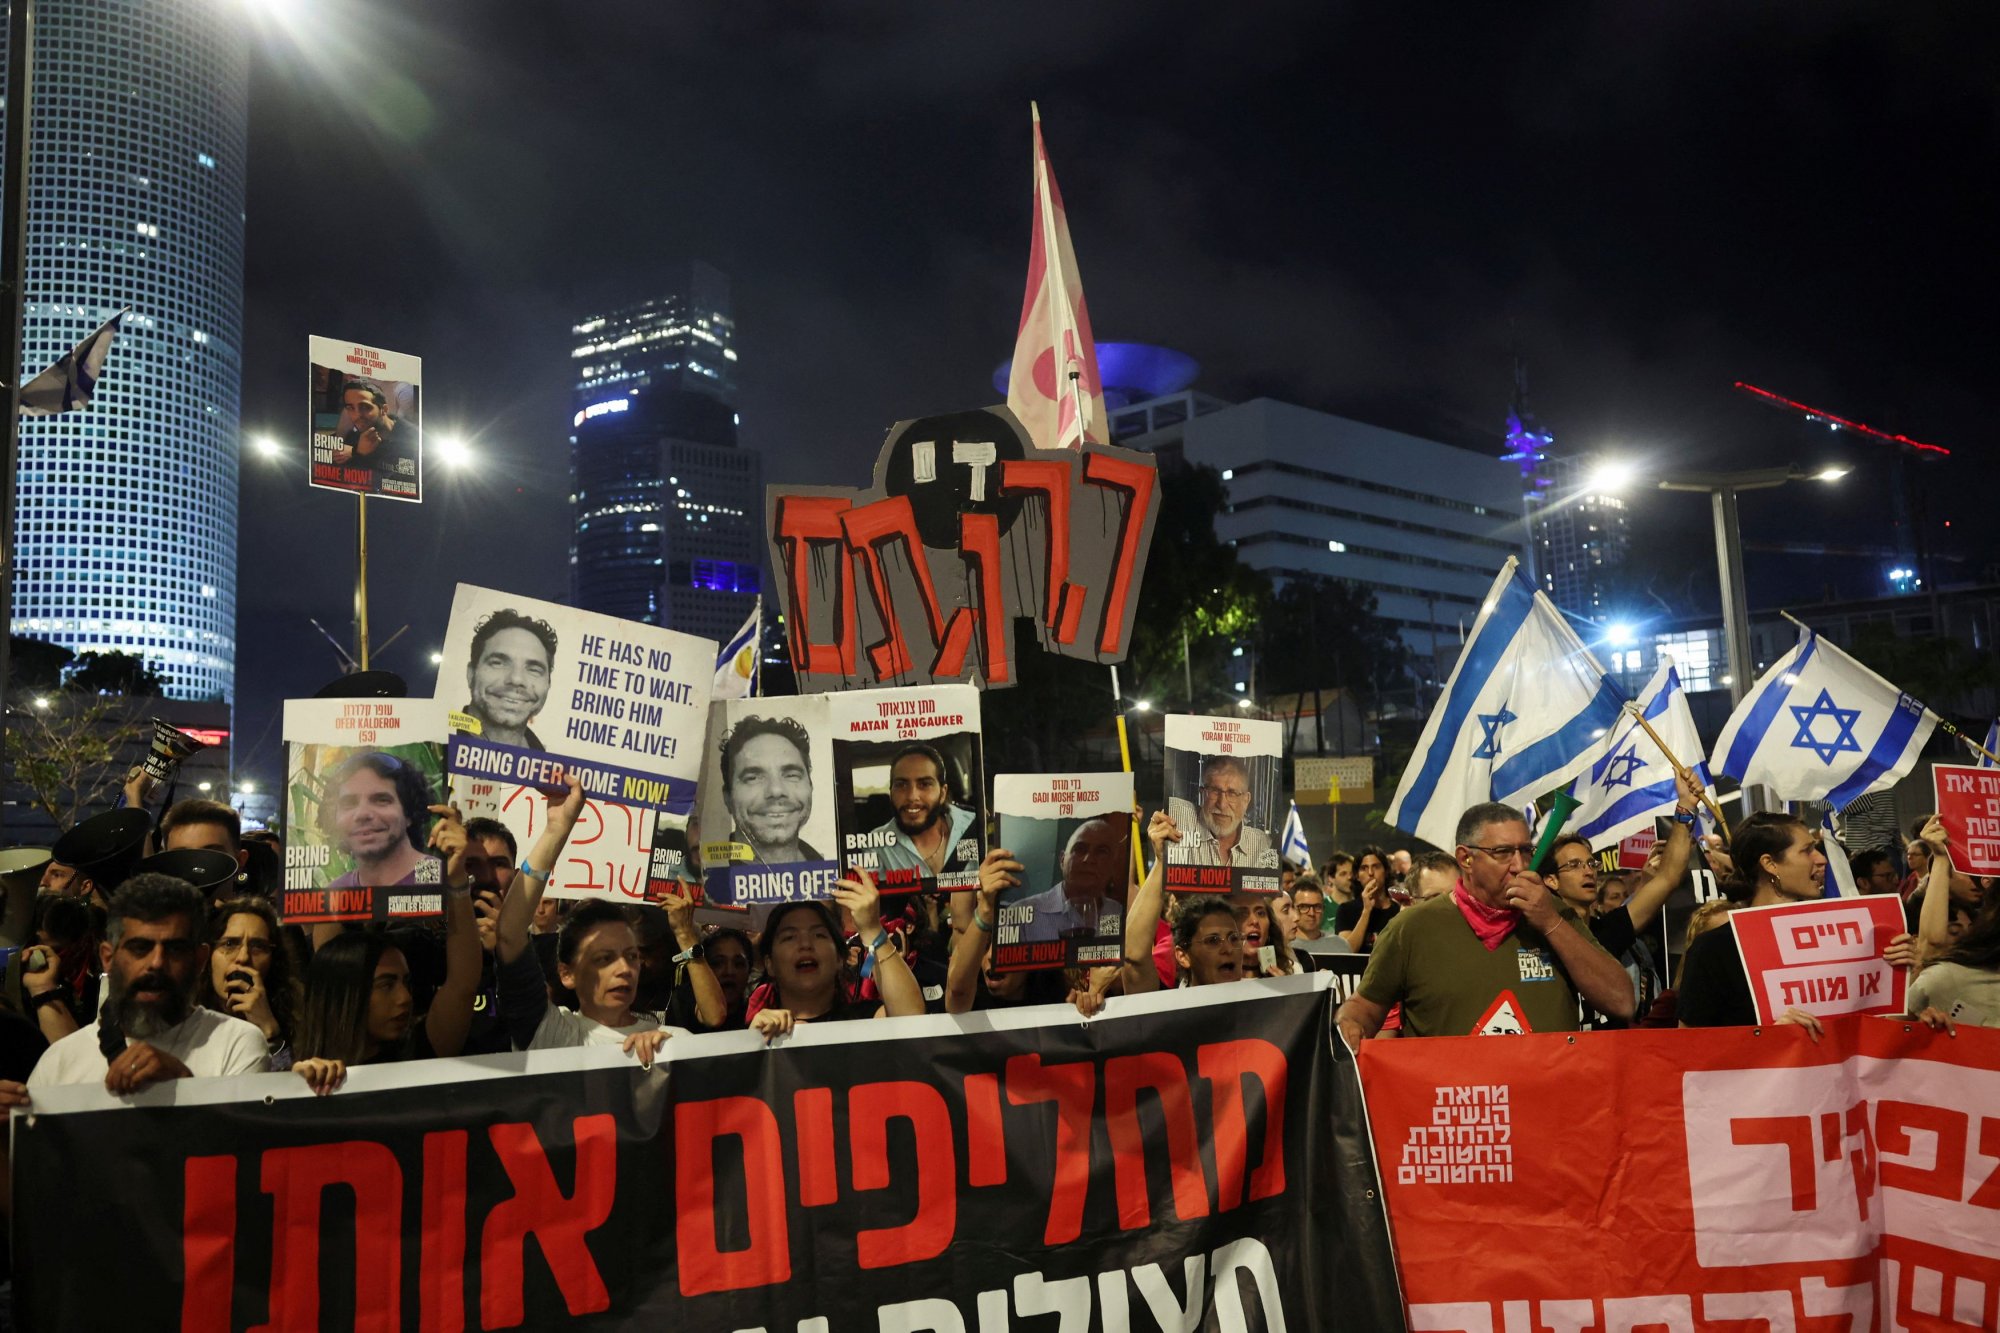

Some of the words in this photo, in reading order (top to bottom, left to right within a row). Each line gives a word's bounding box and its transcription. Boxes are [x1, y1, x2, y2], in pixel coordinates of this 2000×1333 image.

[346, 354, 368, 366] NIMROD
[368, 358, 387, 370] COHEN
[314, 433, 344, 451] BRING
[314, 448, 333, 464] HIM
[314, 465, 342, 480] HOME
[344, 468, 372, 484] NOW!
[581, 634, 606, 658] HE
[608, 640, 644, 666] HAS
[648, 649, 672, 672] NO
[578, 661, 620, 690] TIME
[624, 672, 645, 695] TO
[650, 677, 692, 706] WAIT.
[344, 704, 371, 716] קלדרון
[376, 704, 393, 716] עופר
[571, 689, 625, 719] BRING
[629, 701, 663, 728] HIM
[877, 700, 915, 718] צנגאוקר
[918, 699, 936, 715] מתן
[335, 718, 355, 729] OFER
[358, 718, 400, 729] KALDERON
[850, 720, 889, 732] MATAN
[896, 715, 963, 729] ZANGAUKER
[358, 730, 376, 743] (53)
[566, 716, 618, 747] HOME
[621, 728, 677, 759] ALIVE!
[898, 729, 917, 739] (24)
[1202, 731, 1223, 741] YORAM
[1224, 733, 1251, 744] METZGER
[1220, 743, 1232, 753] (80)
[455, 744, 514, 776] BRING
[516, 756, 564, 786] OFER
[622, 776, 670, 806] NOW!
[1945, 774, 1975, 793] את
[1052, 780, 1069, 790] מוזס
[1070, 779, 1081, 790] גדי
[1032, 792, 1049, 803] GADI
[1051, 792, 1075, 803] MOSHE
[1077, 791, 1099, 802] MOZES
[1059, 804, 1073, 815] (79)
[846, 830, 897, 850] BRING
[285, 845, 330, 867] BRING
[653, 847, 682, 865] BRING
[847, 852, 879, 869] HIM
[1168, 846, 1190, 864] HIM
[284, 868, 314, 890] HIM
[651, 863, 670, 879] HIM
[886, 864, 921, 886] NOW!
[1167, 867, 1197, 884] HOME
[1200, 868, 1231, 885] NOW!
[735, 872, 794, 900] BRING
[800, 869, 838, 897] OFE
[937, 879, 962, 888] FAMILIES
[284, 892, 324, 914] HOME
[330, 887, 372, 912] NOW!
[388, 902, 417, 913] FAMILIES
[418, 901, 442, 912] FORUM
[998, 906, 1034, 926] BRING
[997, 926, 1020, 944] HIM
[1791, 921, 1863, 950] חיים
[996, 945, 1029, 964] HOME
[1032, 940, 1065, 962] NOW!
[1078, 951, 1101, 961] FAMILIES
[1101, 950, 1120, 959] FORUM
[1780, 976, 1849, 1006] מוות
[1859, 971, 1880, 997] או
[1436, 1085, 1509, 1105] מחאת
[1432, 1104, 1510, 1125] הנשים
[1408, 1121, 1510, 1144] להחזרת
[1402, 1144, 1512, 1164] החטופות
[674, 1038, 1288, 1297] מחליפים
[1398, 1164, 1513, 1184] והחטופים
[180, 1113, 617, 1333] אותו
